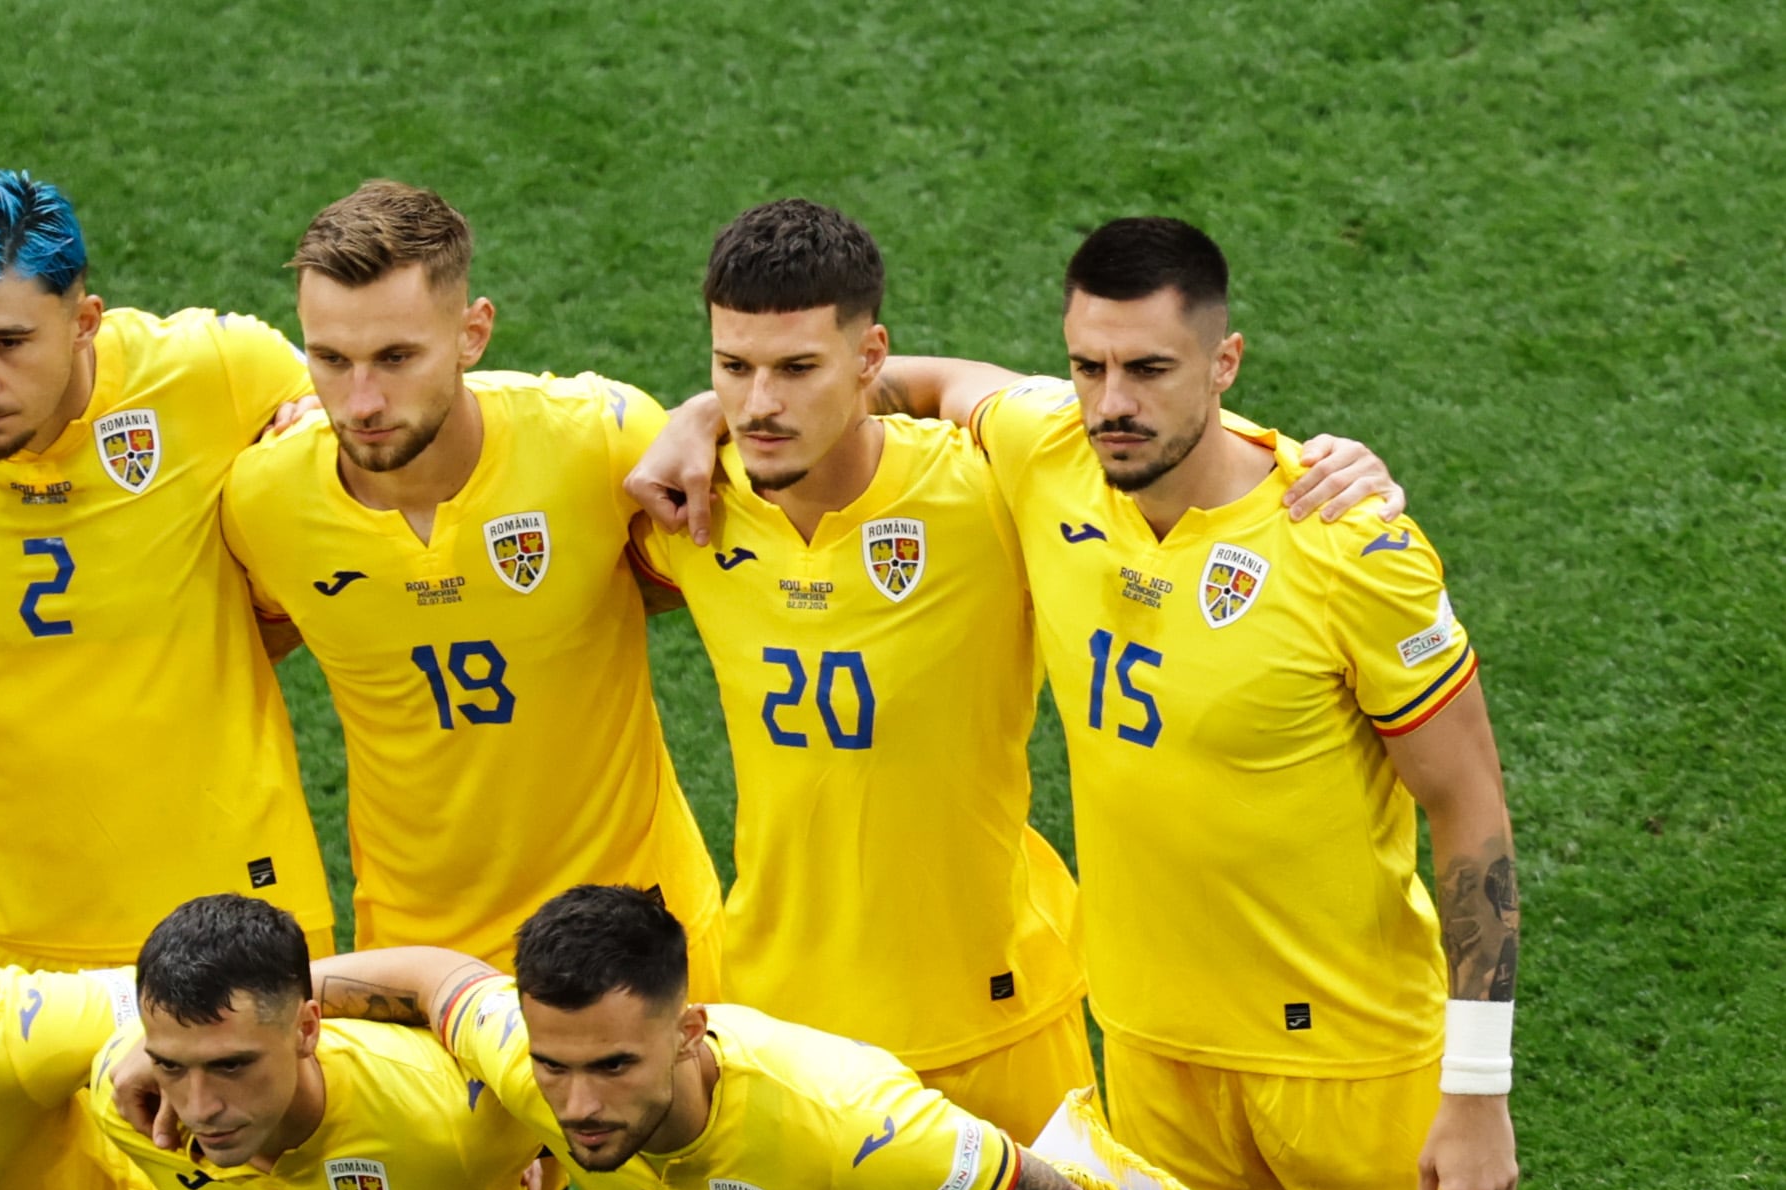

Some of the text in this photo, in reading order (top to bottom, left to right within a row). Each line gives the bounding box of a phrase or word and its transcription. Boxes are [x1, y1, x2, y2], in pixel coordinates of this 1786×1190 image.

[100, 412, 151, 434] ROMÂNIA
[490, 516, 540, 537] ROMÂNIA
[868, 521, 919, 538] ROMÂNIA
[1216, 548, 1263, 575] ROMÂNIA
[18, 537, 76, 637] 2
[405, 581, 430, 592] ROU
[440, 576, 465, 589] NED
[779, 579, 801, 592] ROU
[810, 581, 834, 593] NED
[1120, 567, 1142, 583] ROU
[1150, 577, 1173, 593] NED
[411, 639, 516, 730] 19
[1087, 628, 1164, 749] 15
[761, 646, 876, 750] 20
[330, 1161, 380, 1175] ROMÂNIA
